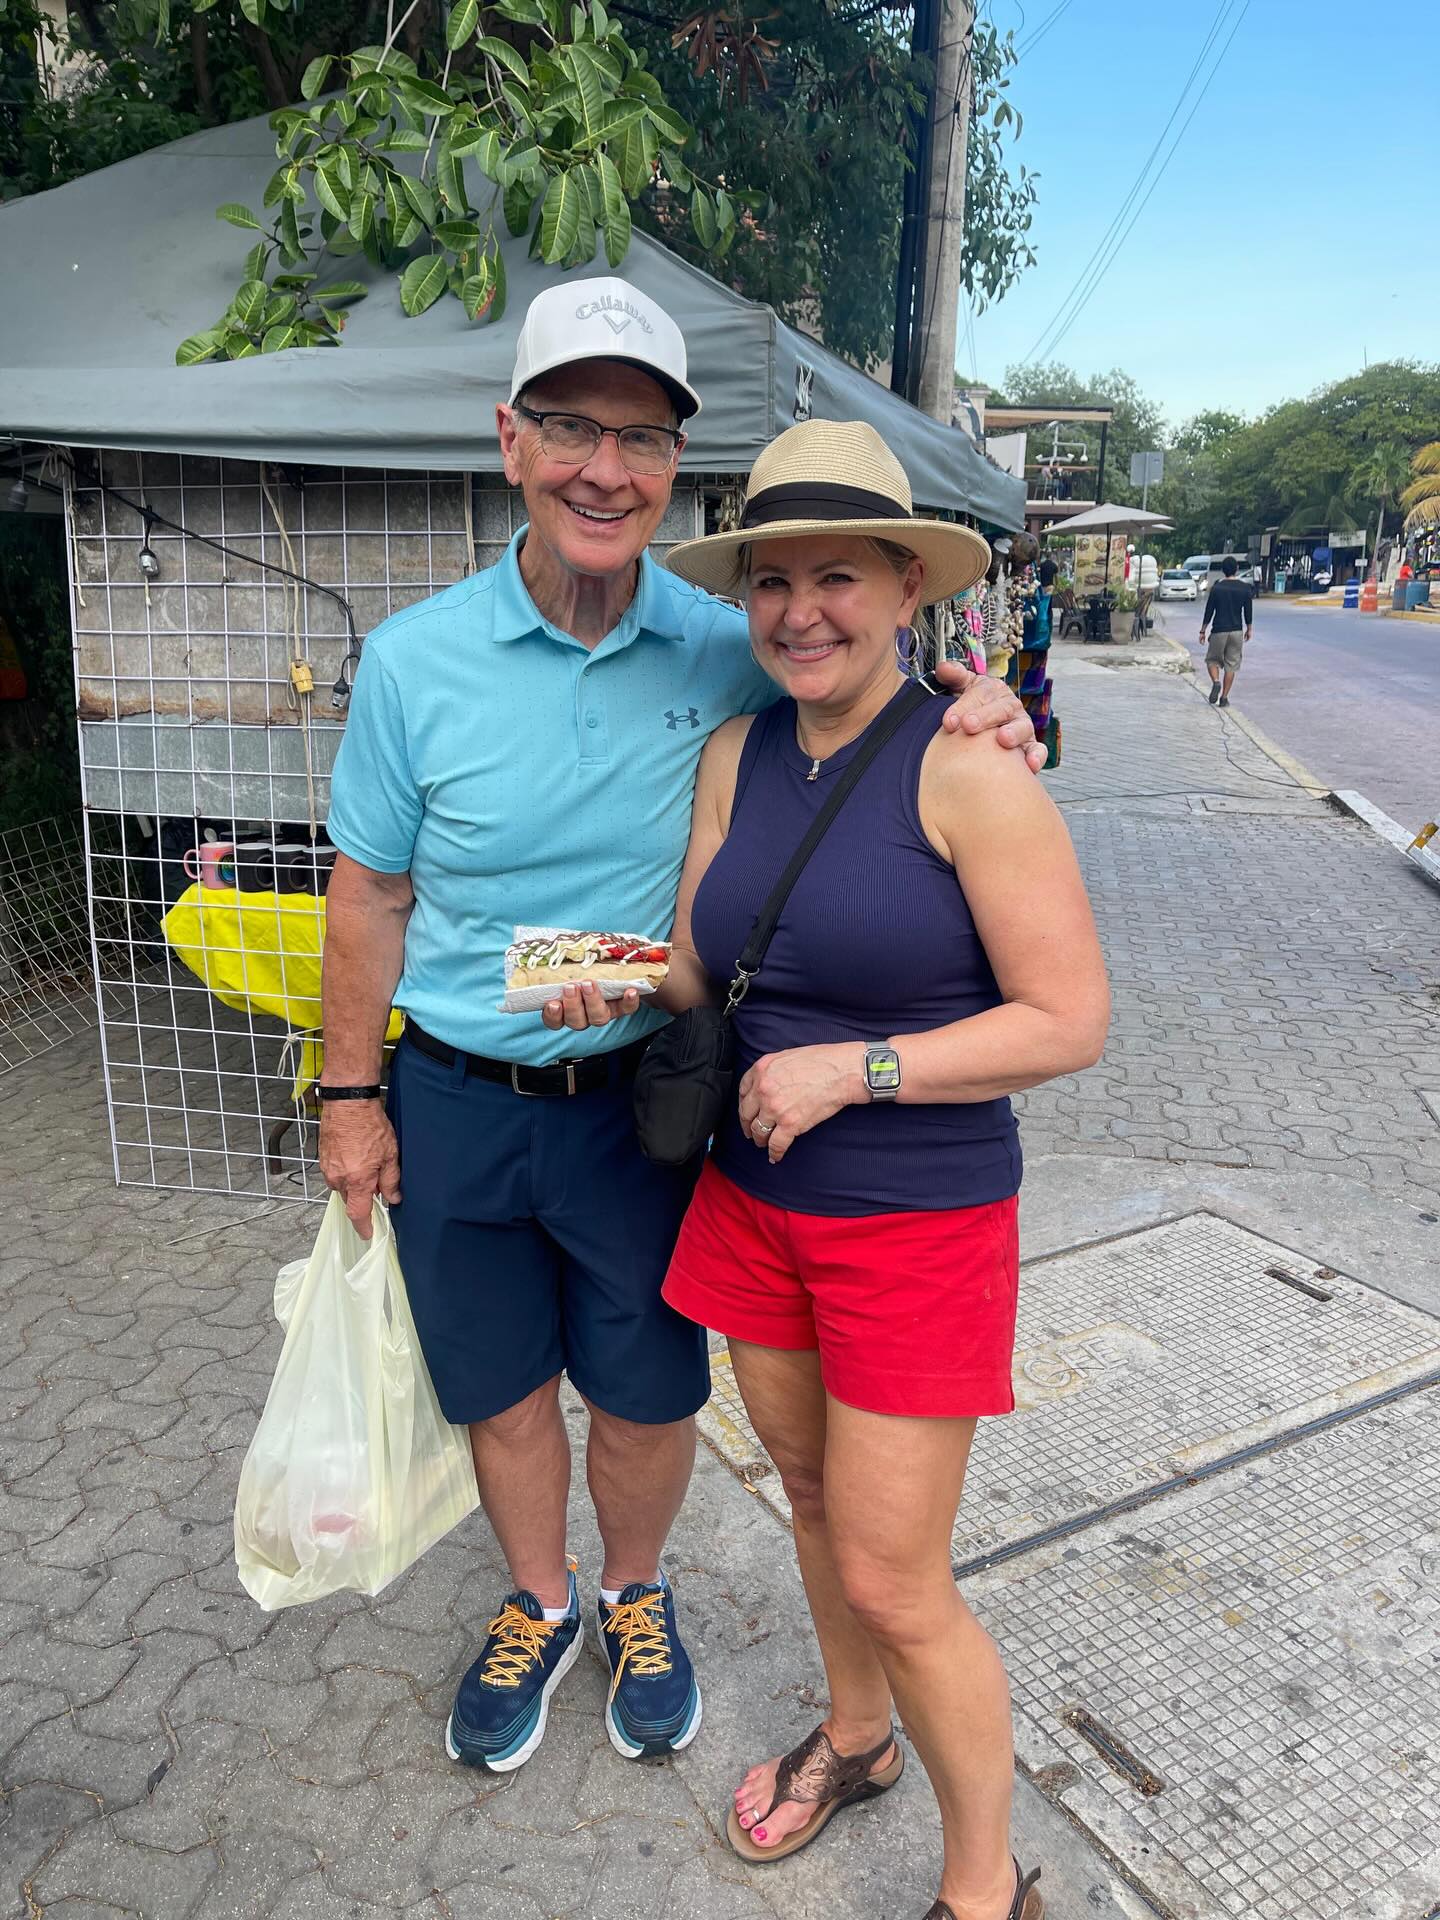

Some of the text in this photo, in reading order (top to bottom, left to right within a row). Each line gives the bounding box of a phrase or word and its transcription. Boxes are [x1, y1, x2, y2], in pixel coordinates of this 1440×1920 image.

[576, 295, 654, 334] Callaway
[1023, 1336, 1129, 1388] CFE
[1096, 1476, 1134, 1498] 508
[1134, 1463, 1160, 1483] 48
[1158, 1456, 1185, 1474] 66
